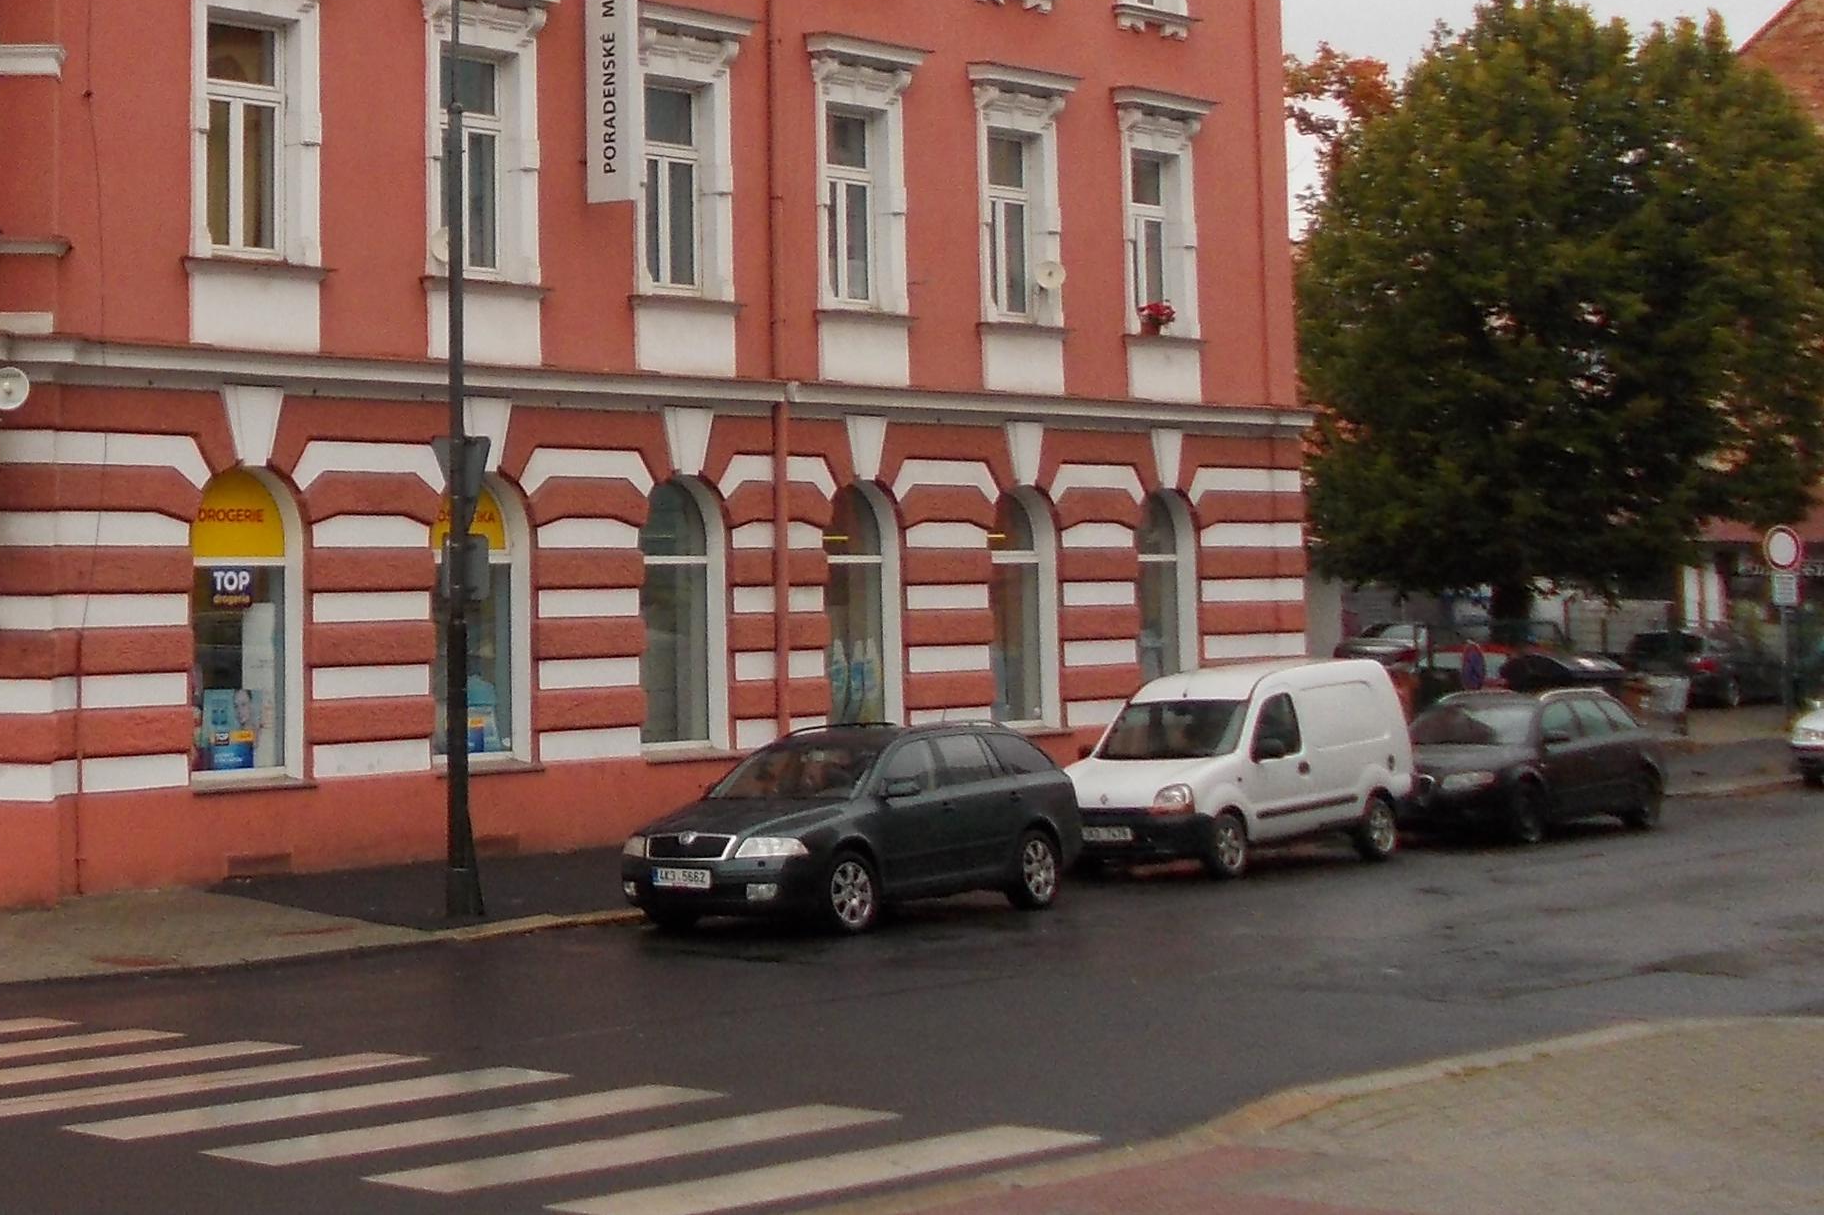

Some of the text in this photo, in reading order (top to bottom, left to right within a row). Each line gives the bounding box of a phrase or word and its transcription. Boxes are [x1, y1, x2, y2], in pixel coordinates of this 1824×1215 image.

[600, 33, 617, 174] PORADENSKÉ
[198, 508, 264, 523] DROGERIE
[213, 571, 250, 591] TOP
